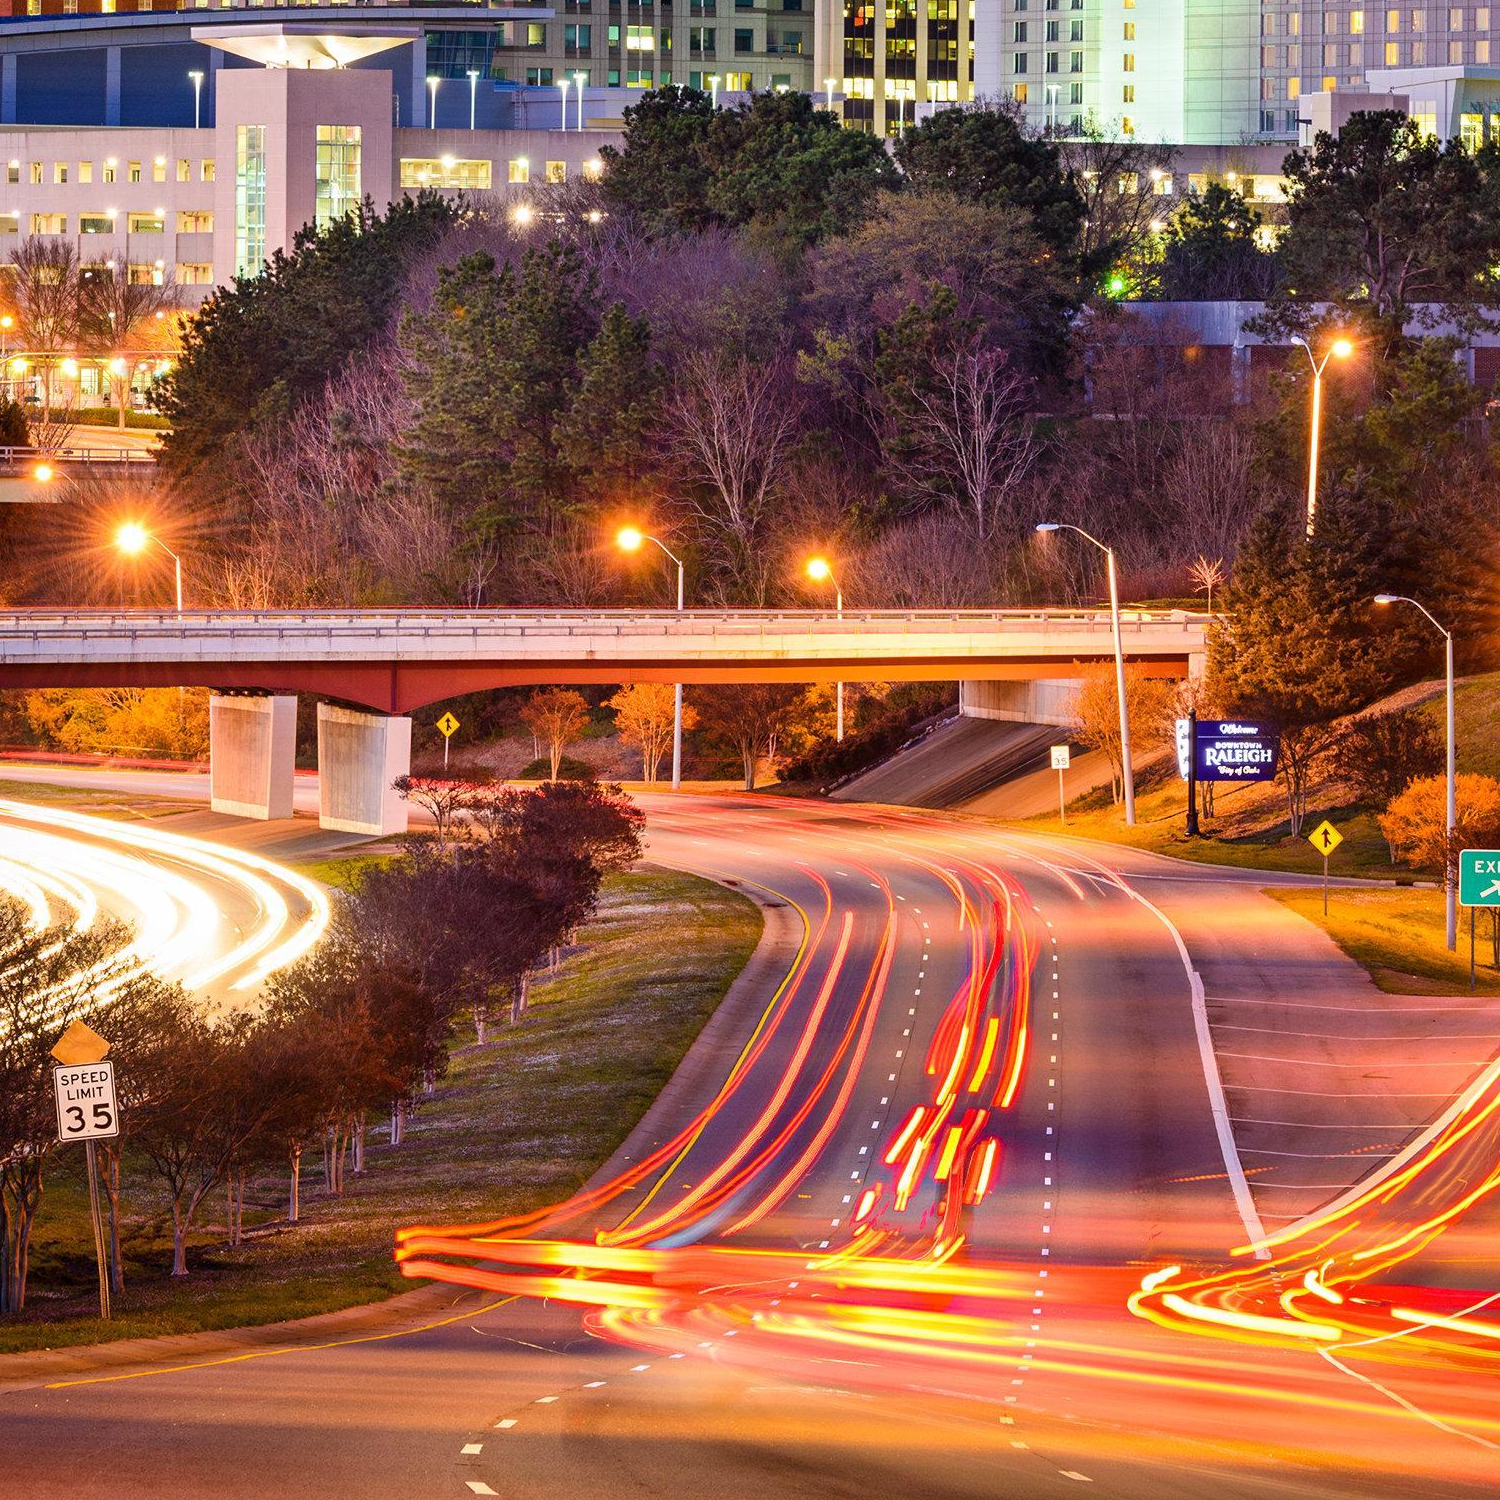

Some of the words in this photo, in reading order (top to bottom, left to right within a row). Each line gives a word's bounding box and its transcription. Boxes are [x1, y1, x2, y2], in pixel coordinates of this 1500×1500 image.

[1205, 748, 1272, 766] RALEIGH
[1235, 766, 1243, 776] of
[61, 1071, 108, 1086] SPEED
[67, 1086, 103, 1100] LIMIT
[66, 1102, 113, 1133] 35
